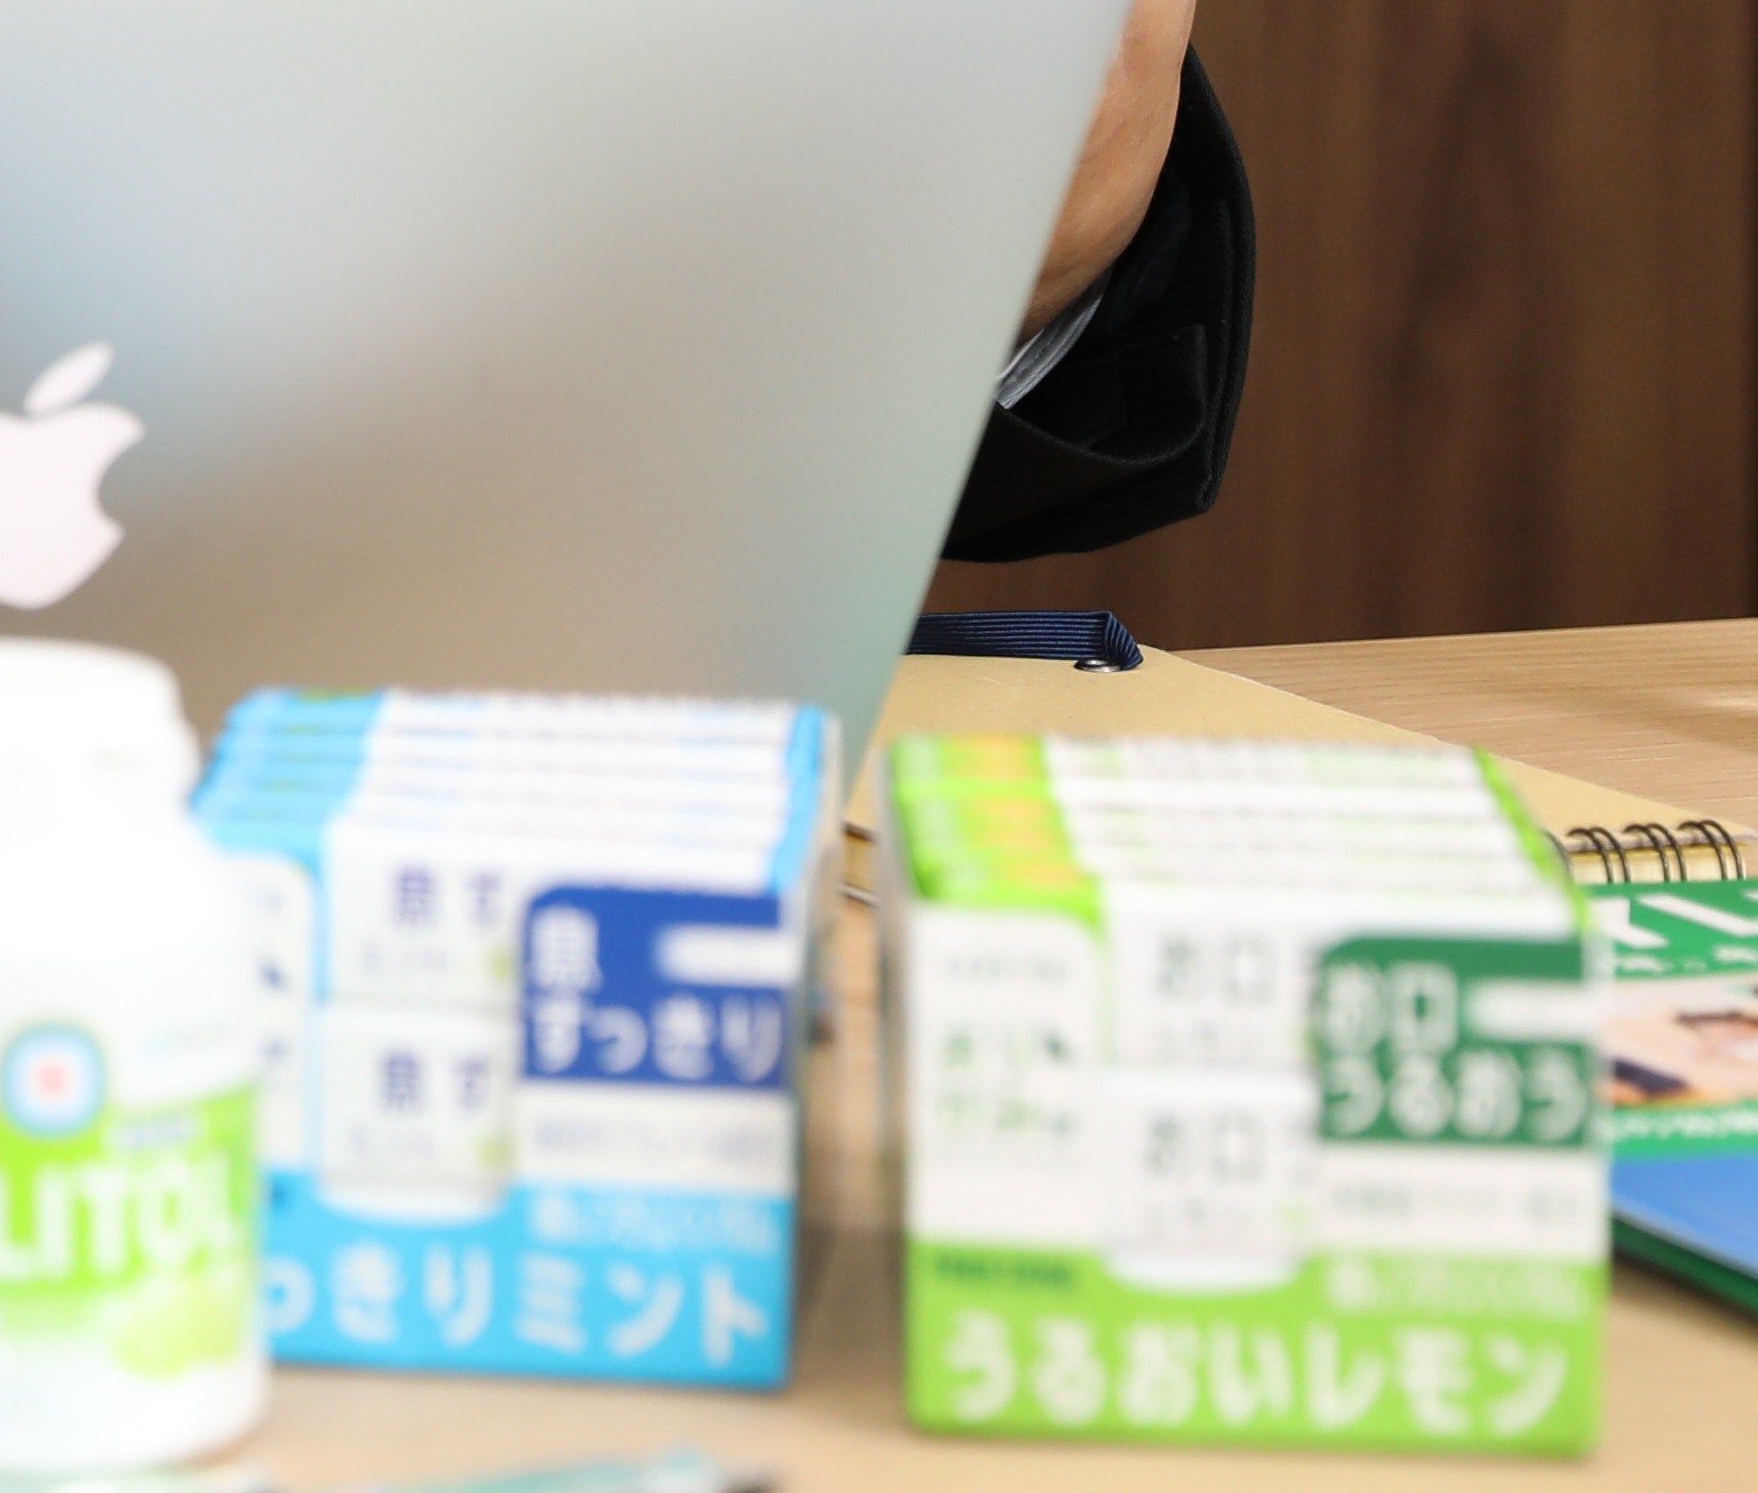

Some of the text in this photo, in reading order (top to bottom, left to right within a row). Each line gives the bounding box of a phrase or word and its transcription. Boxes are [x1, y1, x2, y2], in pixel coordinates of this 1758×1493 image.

[528, 991, 783, 1082] すっきり
[1322, 1051, 1587, 1142] うるおう
[942, 1309, 1569, 1438] うるおいレモン
